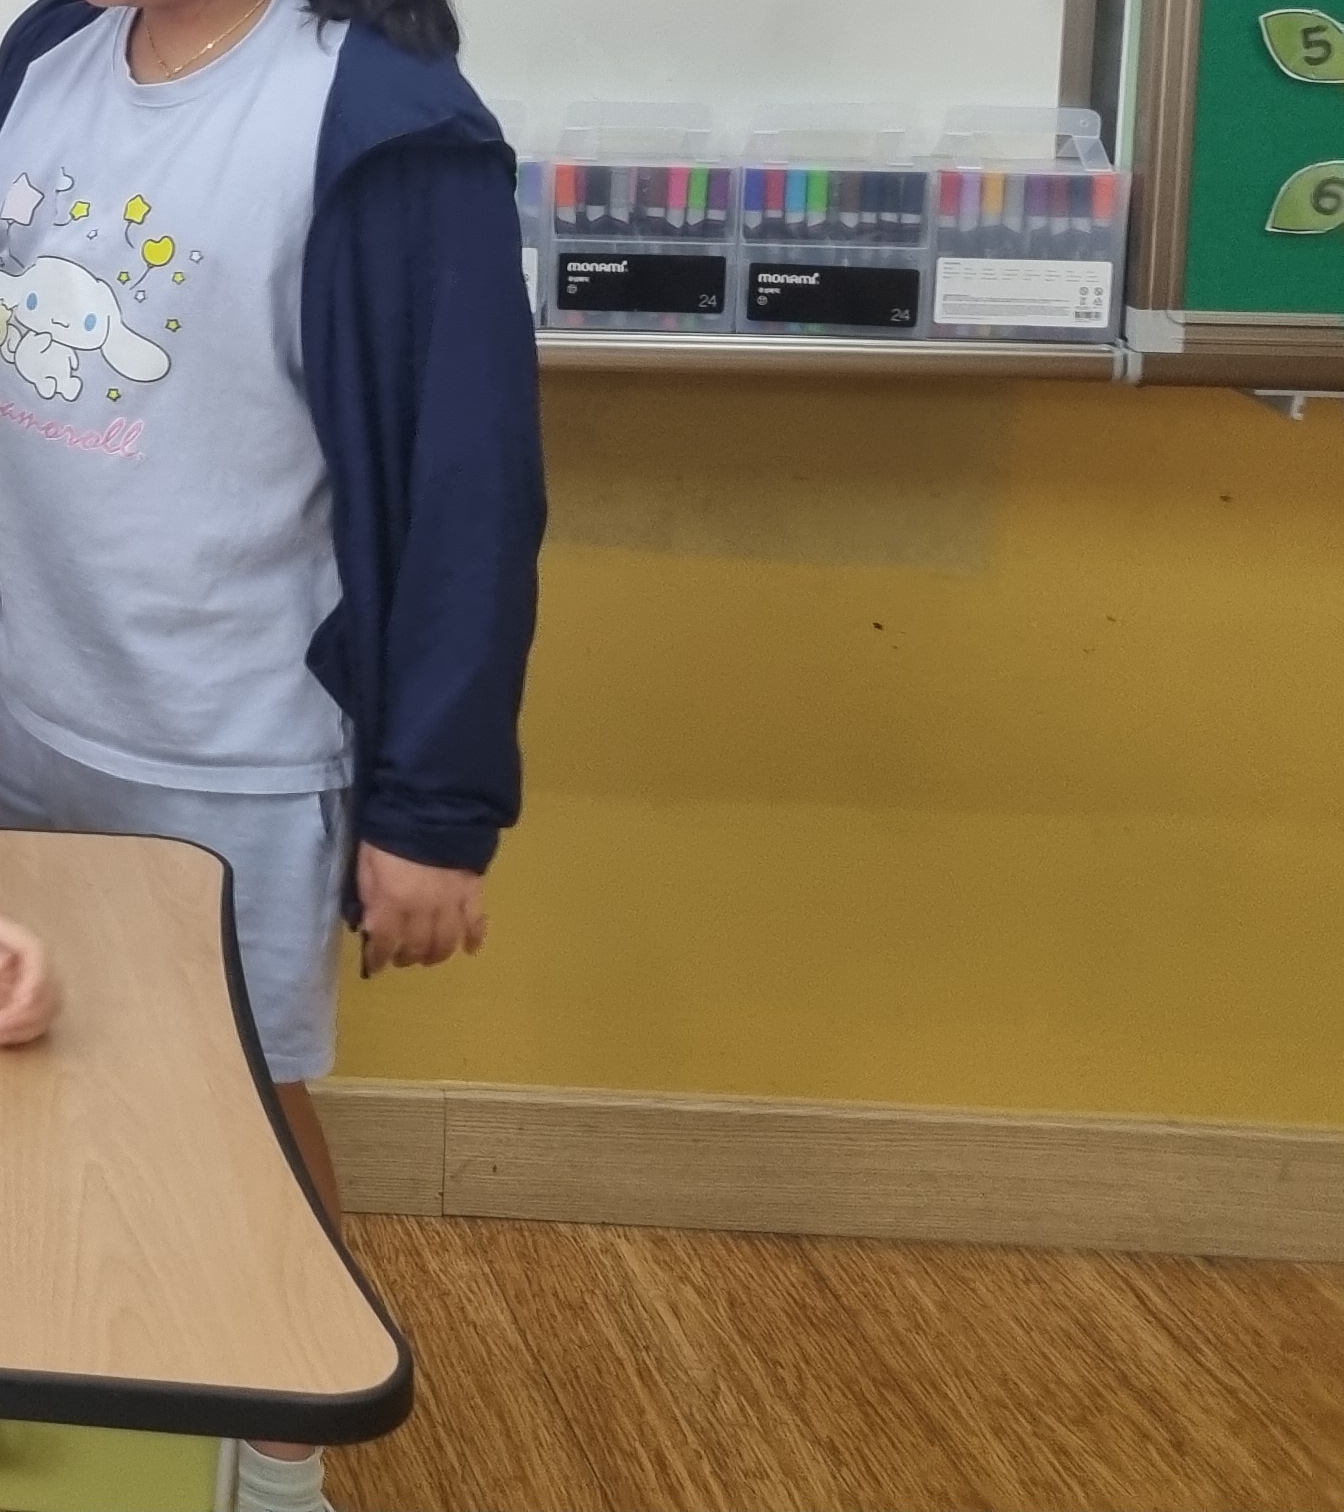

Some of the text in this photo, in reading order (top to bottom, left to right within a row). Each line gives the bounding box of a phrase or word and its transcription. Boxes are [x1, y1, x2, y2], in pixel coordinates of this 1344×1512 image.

[1300, 24, 1333, 67] 5
[1310, 176, 1344, 217] 6
[697, 294, 718, 308] 24
[889, 307, 911, 322] 24
